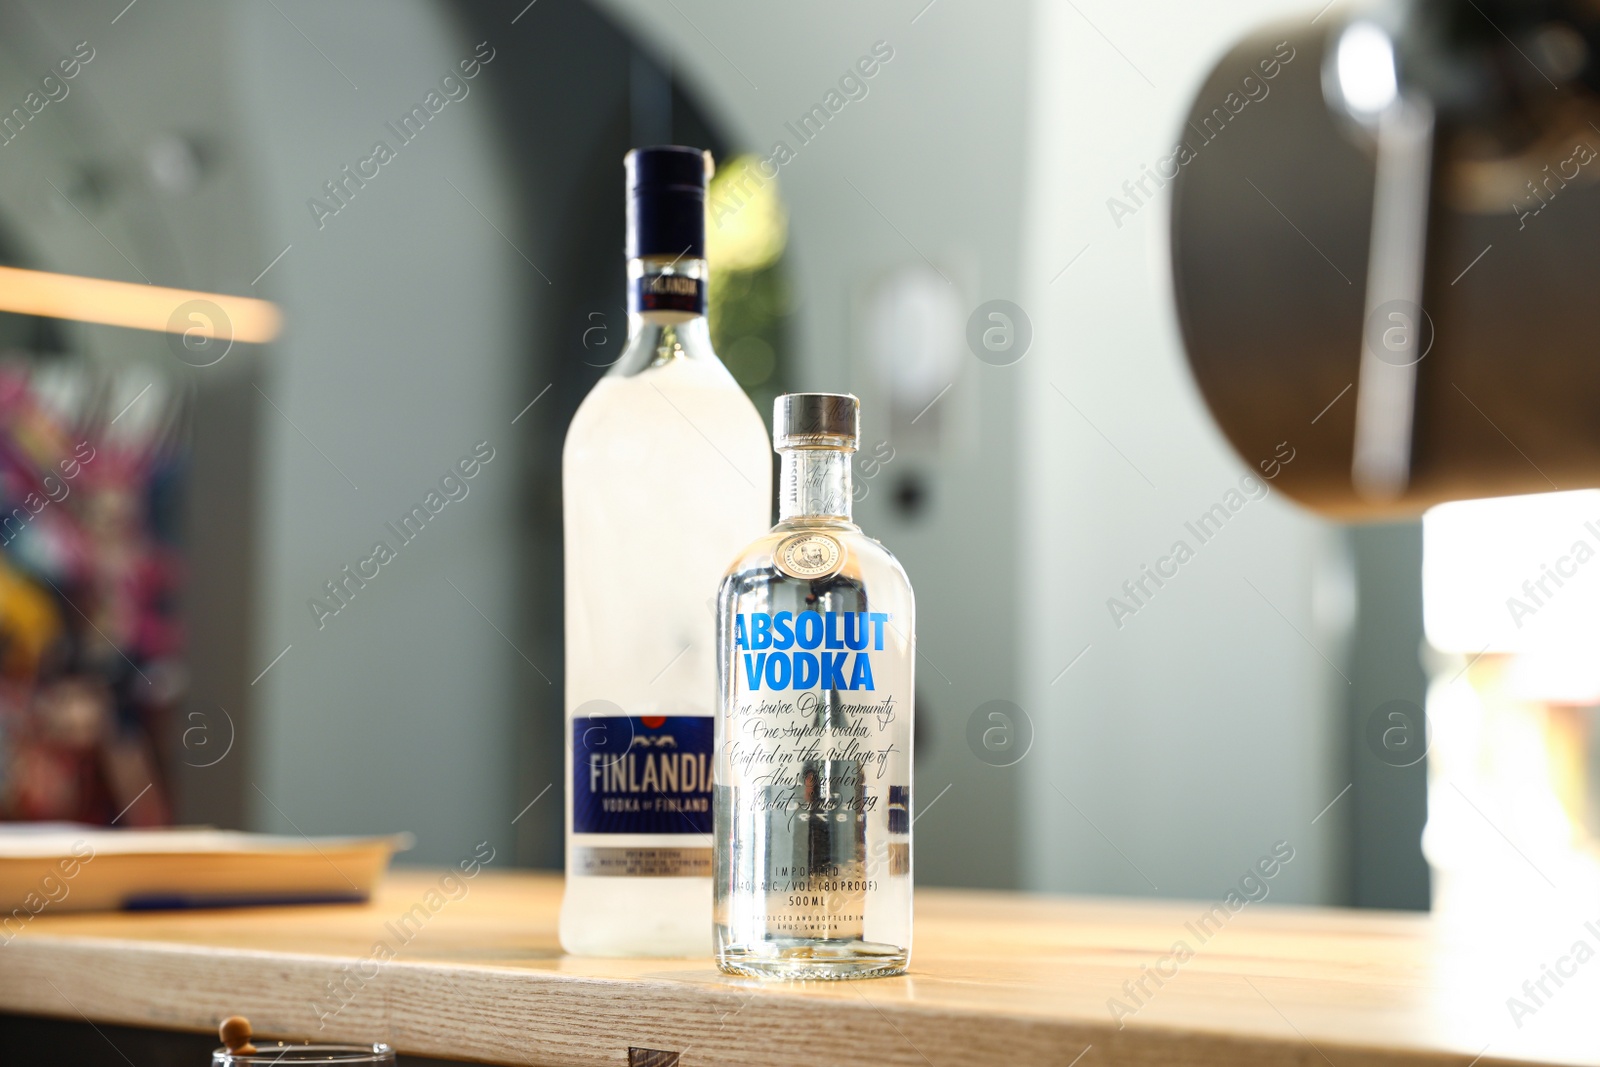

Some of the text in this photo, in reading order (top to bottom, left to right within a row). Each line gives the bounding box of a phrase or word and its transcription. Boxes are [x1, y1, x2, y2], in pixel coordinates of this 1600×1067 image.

[735, 610, 888, 650] ABSOLUT
[744, 652, 875, 691] VODKA
[797, 692, 831, 718] One
[743, 717, 780, 740] One
[778, 750, 793, 763] in
[793, 738, 824, 763] the
[827, 737, 876, 774] village
[875, 743, 901, 779] of
[602, 798, 640, 812] VODKA
[655, 798, 709, 813] FINLAND
